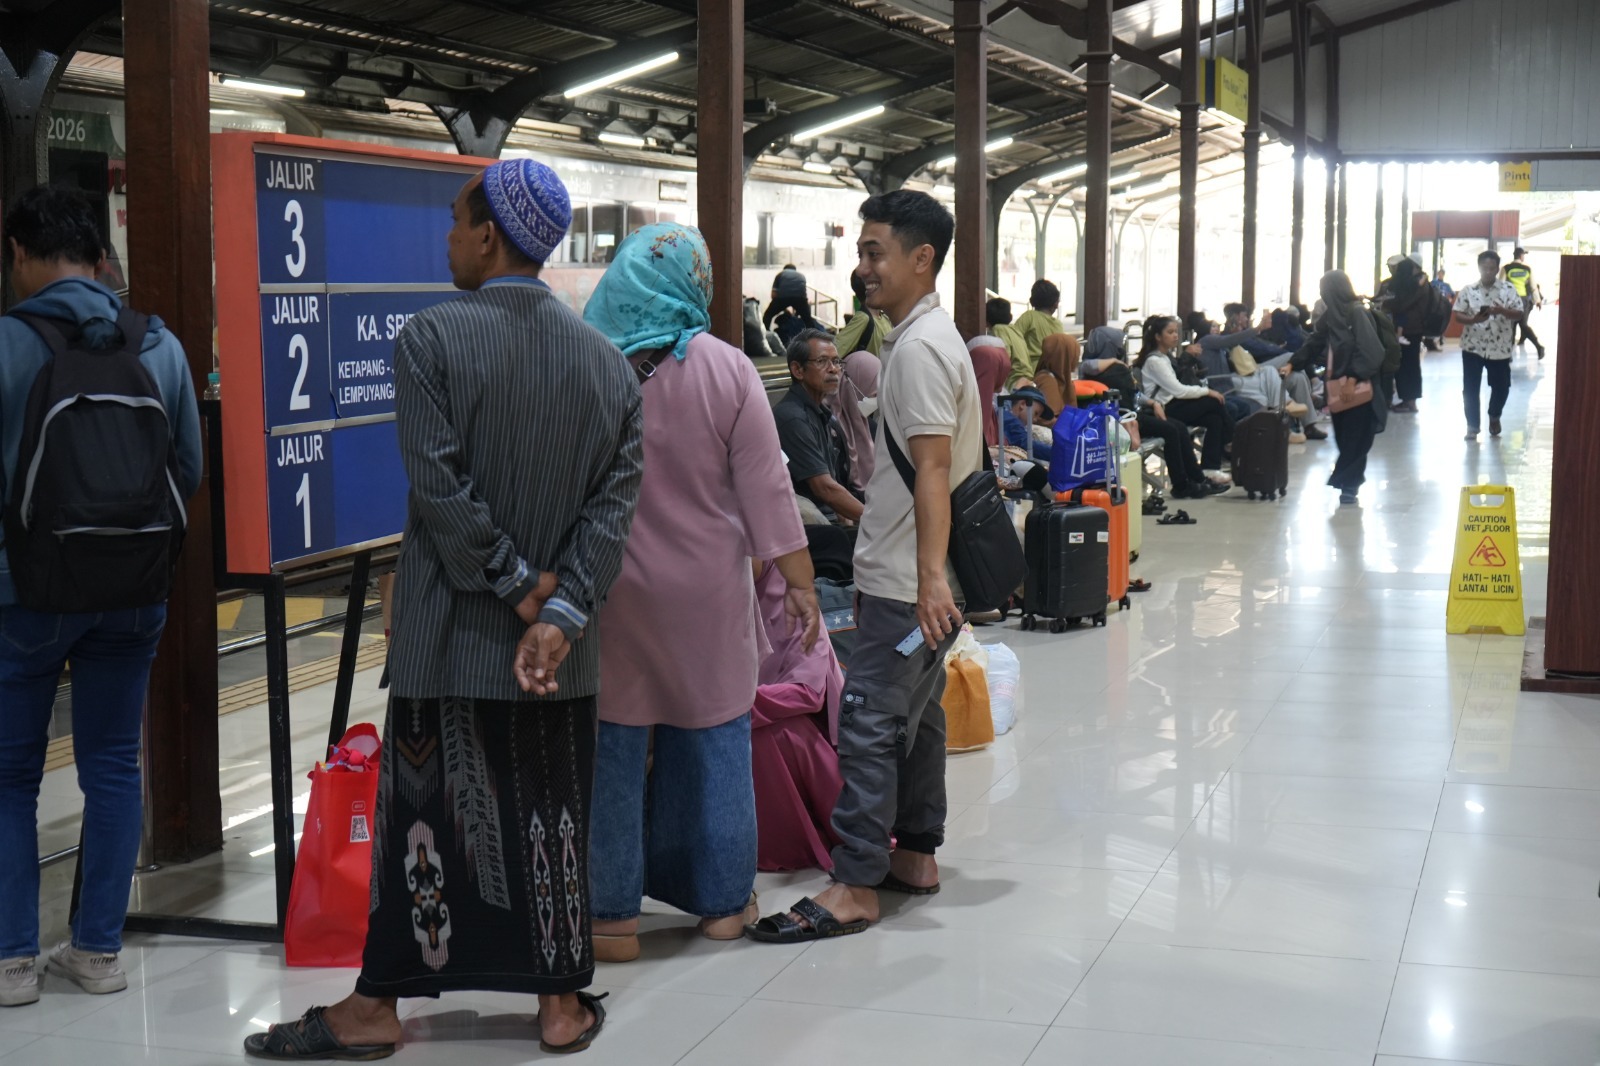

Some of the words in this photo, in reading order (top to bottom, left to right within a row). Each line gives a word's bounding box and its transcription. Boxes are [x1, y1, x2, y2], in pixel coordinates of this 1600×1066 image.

[48, 117, 86, 142] 2026
[266, 160, 315, 191] JALUR
[284, 199, 306, 278] 3
[272, 296, 320, 325] JALUR
[357, 314, 382, 341] KA.
[386, 313, 416, 340] SR
[288, 333, 311, 411] 2
[338, 359, 385, 379] KETAPANG
[277, 434, 324, 467] JALUR
[295, 472, 312, 549] 1
[1468, 515, 1507, 523] CAUTION
[1464, 524, 1481, 532] WET
[1459, 584, 1488, 592] LANTAI
[1493, 585, 1514, 593] LICIN
[1462, 573, 1482, 582] HATI
[1491, 574, 1511, 583] HATI
